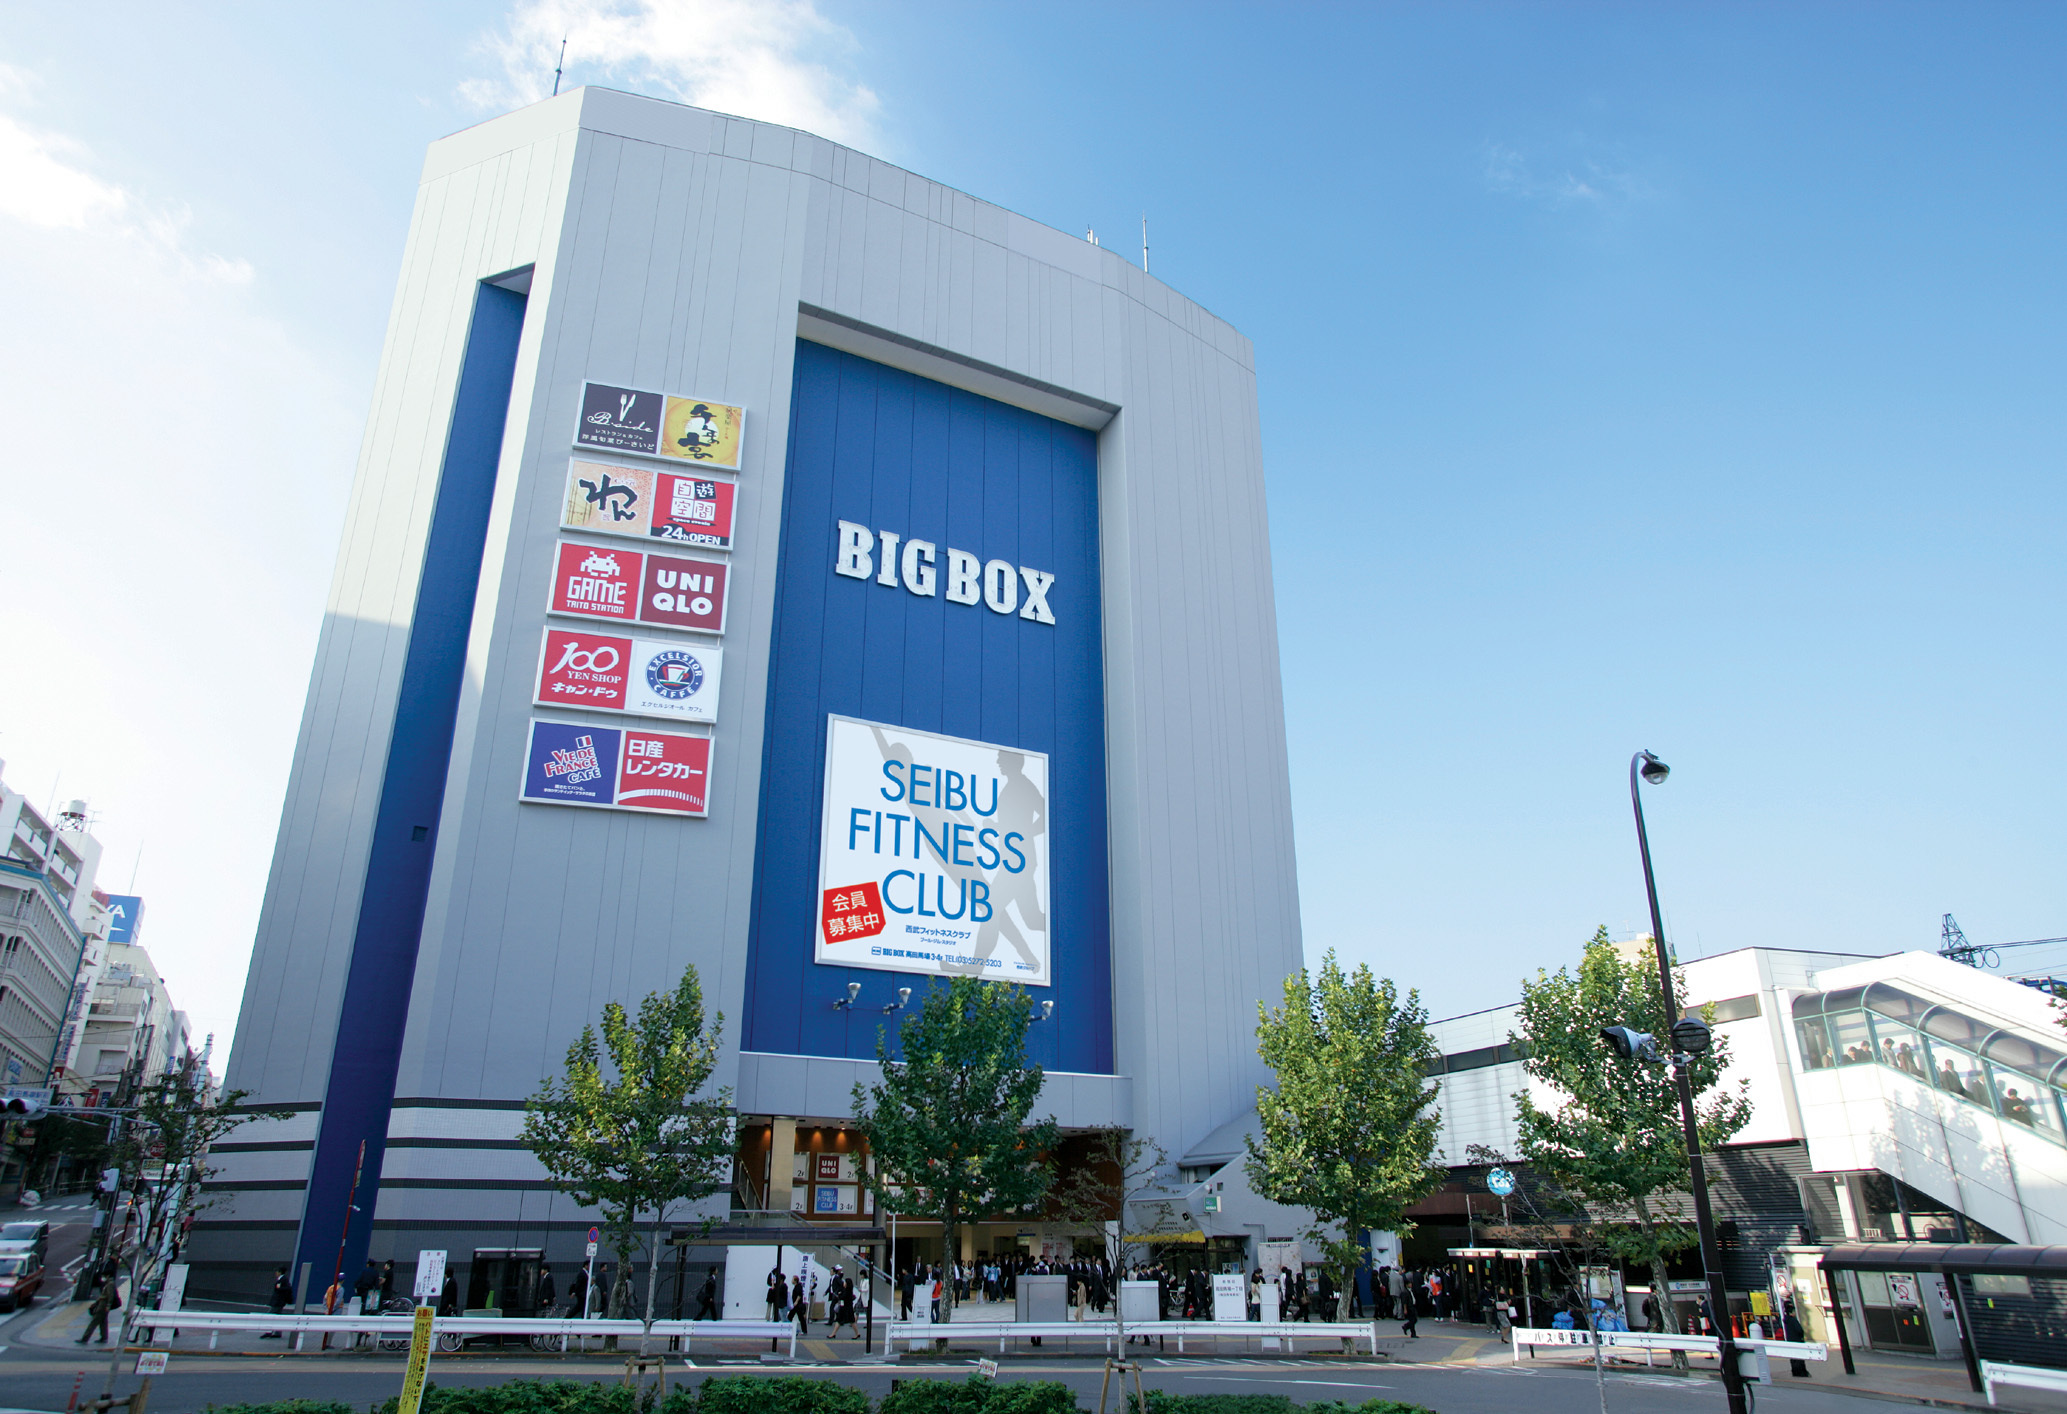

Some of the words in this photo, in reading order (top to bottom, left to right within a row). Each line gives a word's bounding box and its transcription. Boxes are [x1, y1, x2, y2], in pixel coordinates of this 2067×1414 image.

[579, 474, 638, 521] わん
[656, 569, 714, 594] UNI
[835, 518, 937, 598] BIG
[946, 548, 1057, 626] BOX
[566, 576, 628, 605] GAME
[566, 600, 589, 610] TAITO
[590, 602, 624, 614] STATION
[652, 592, 713, 616] QLO
[549, 641, 620, 675] 100
[648, 652, 703, 677] EXCELSIOR
[566, 670, 591, 681] YEN
[592, 673, 622, 684] SHOP
[551, 748, 576, 764] VIE
[576, 746, 596, 760] DE
[628, 738, 664, 759] 日産
[544, 757, 598, 778] FRANCE
[626, 759, 704, 780] レンタカー
[880, 759, 999, 818] SEIBU
[848, 807, 1027, 875] FITNESS
[832, 890, 869, 915] 会員
[882, 868, 995, 924] CLUB
[827, 910, 882, 938] 募集中
[905, 924, 972, 940] 西武フィットネスクラブ
